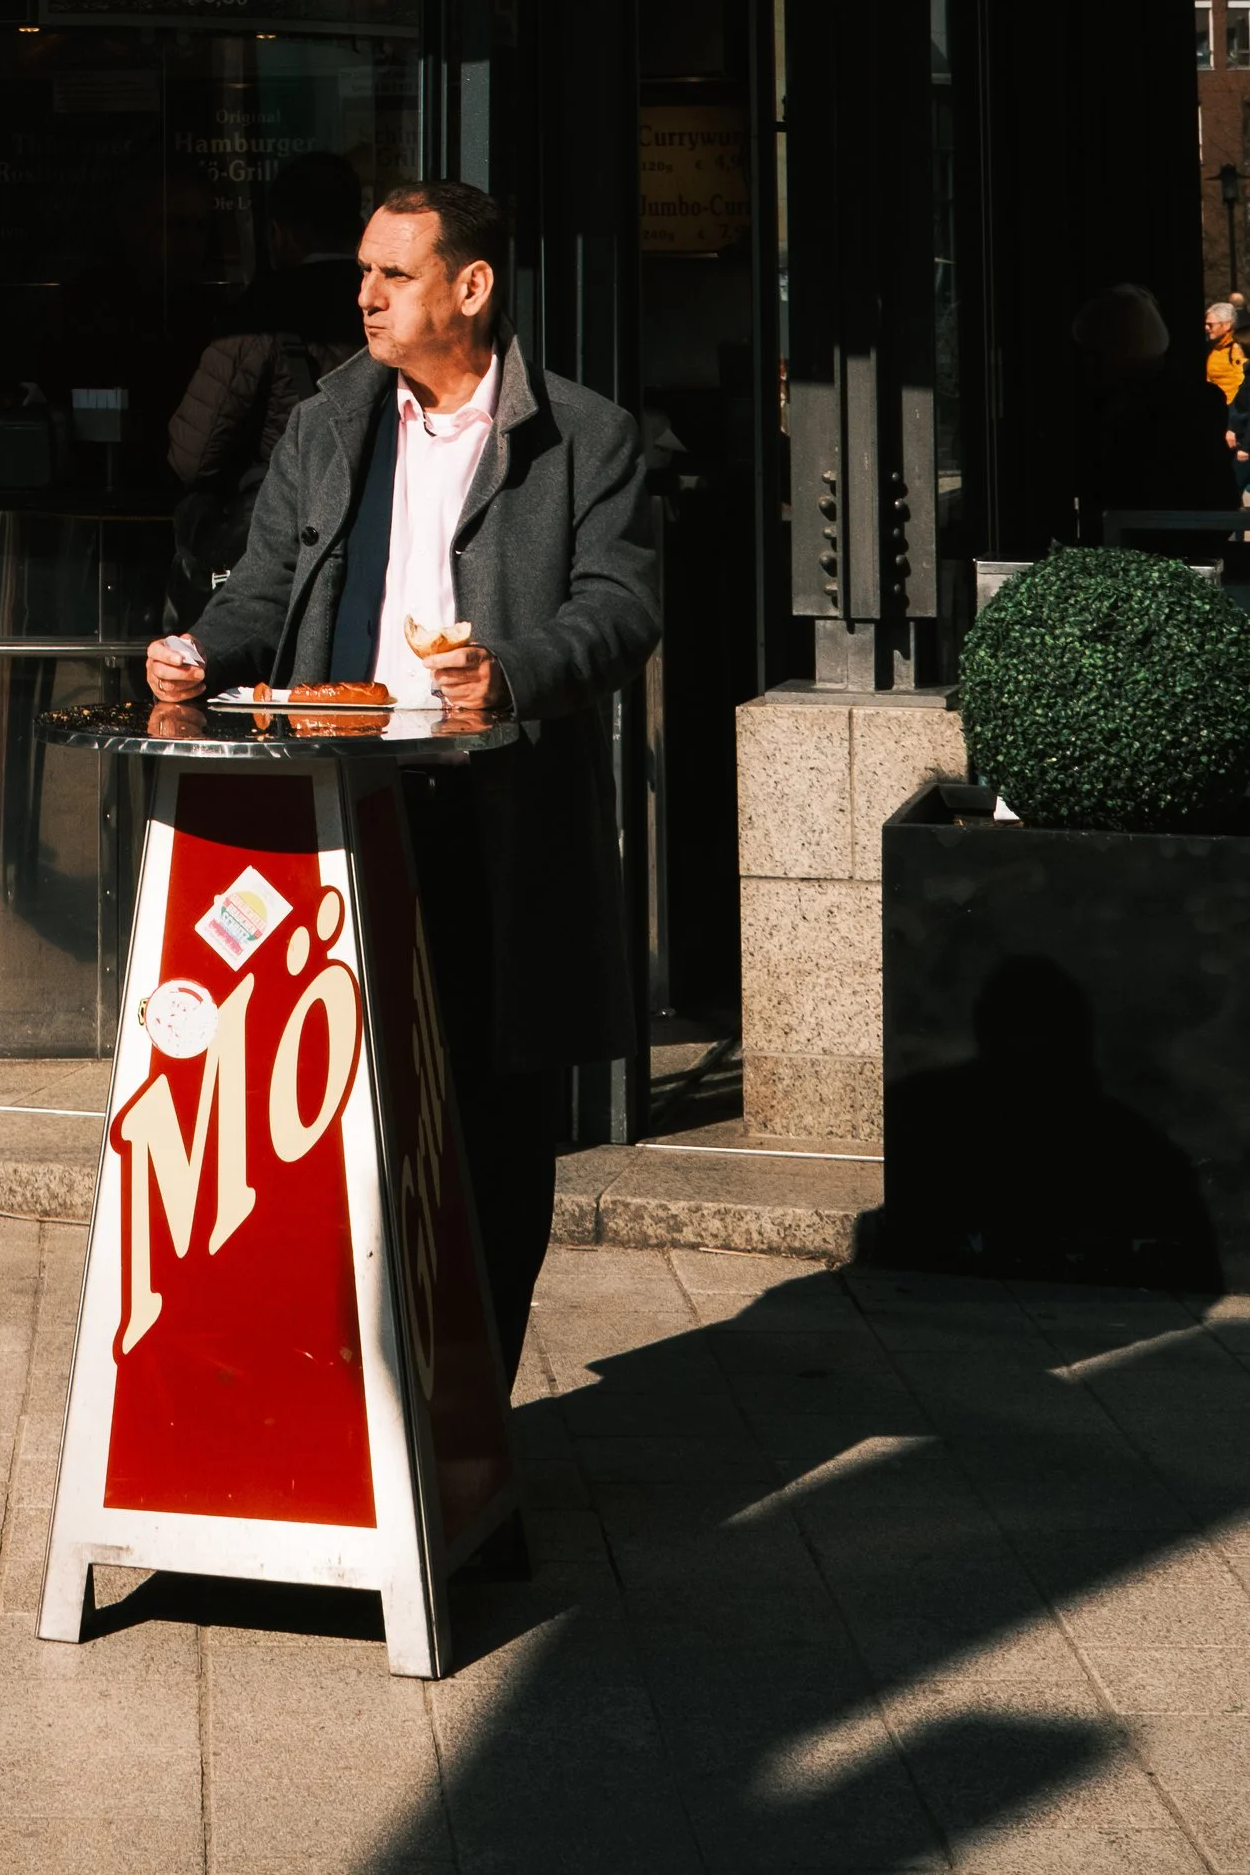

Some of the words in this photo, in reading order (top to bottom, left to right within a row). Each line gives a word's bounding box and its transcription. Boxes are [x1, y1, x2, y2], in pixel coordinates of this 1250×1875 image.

[173, 131, 319, 157] Hamburger
[197, 158, 280, 183] ö-Grill
[121, 890, 358, 1355] Mö
